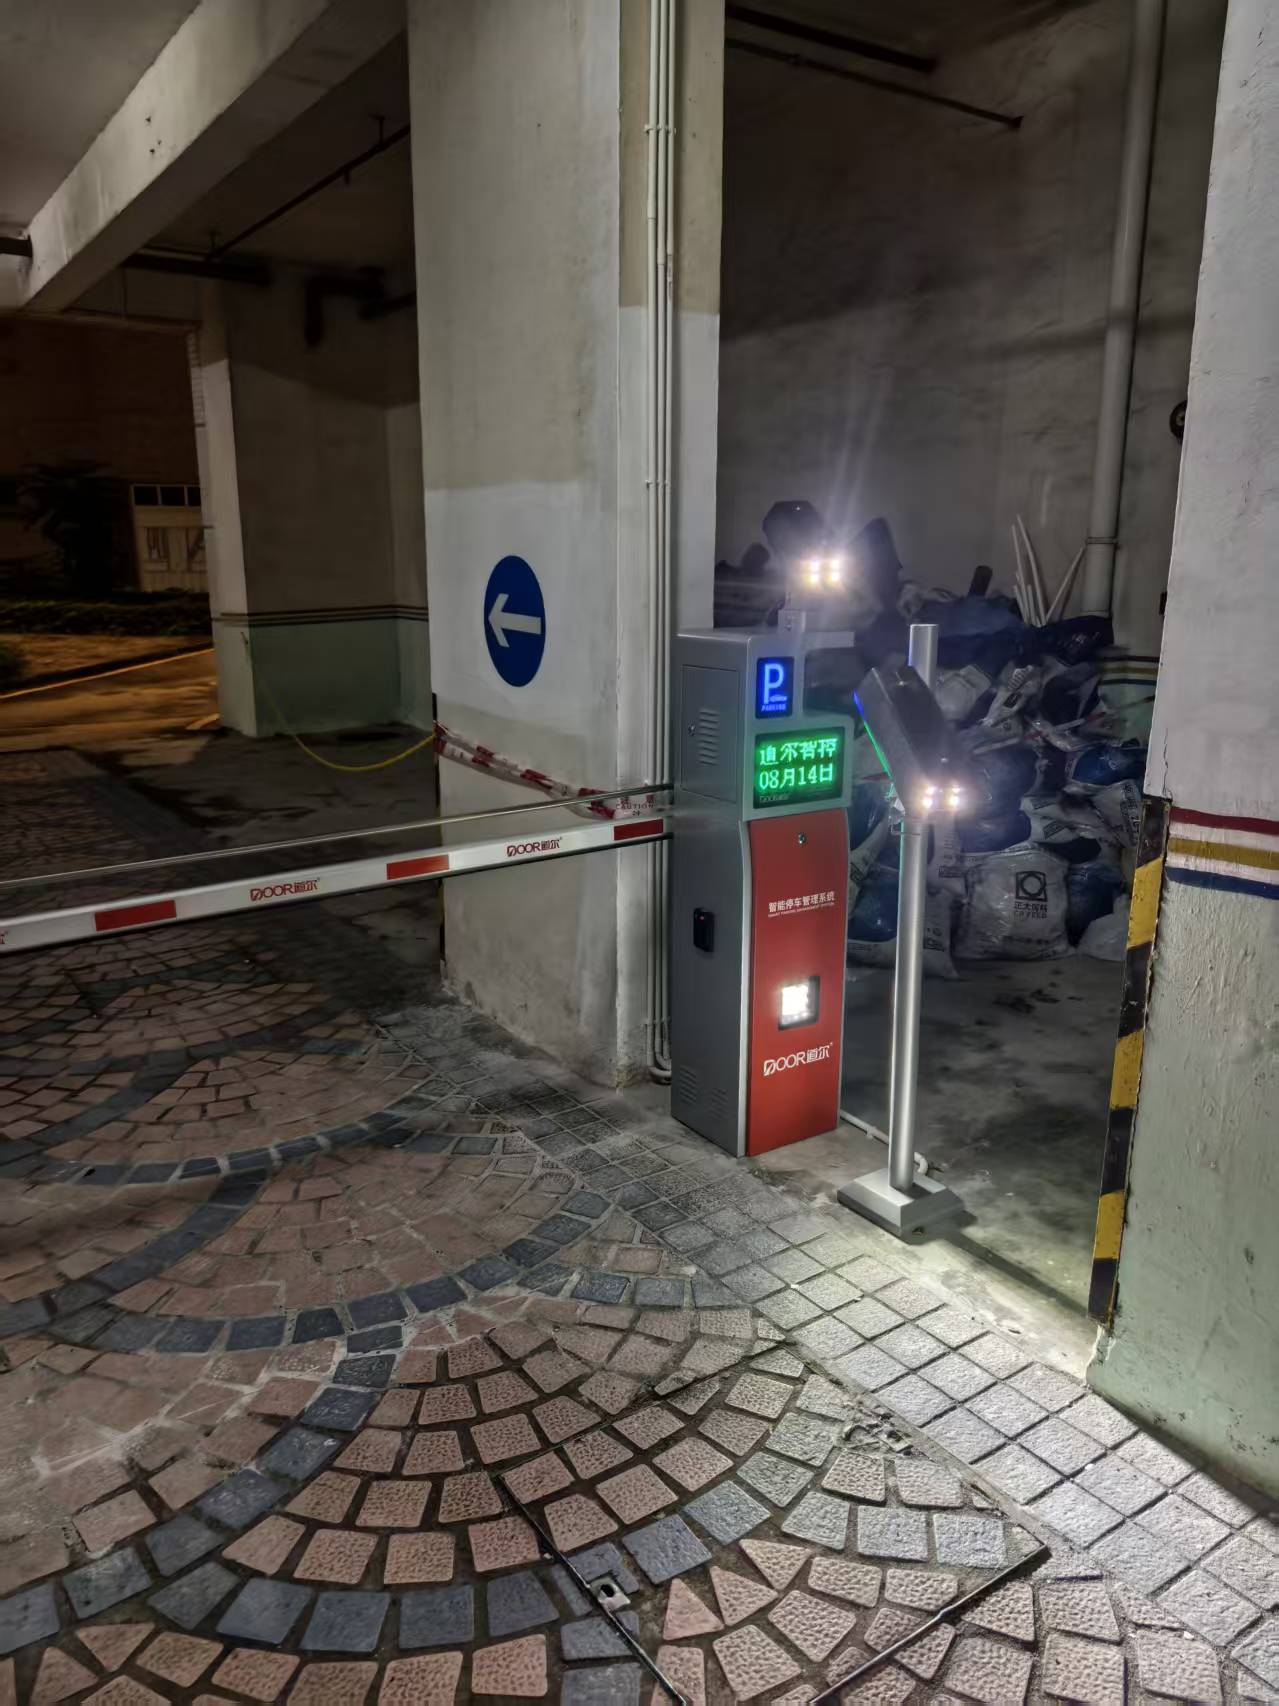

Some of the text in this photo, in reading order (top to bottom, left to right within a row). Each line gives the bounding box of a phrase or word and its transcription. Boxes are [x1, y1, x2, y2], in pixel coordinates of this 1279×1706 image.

[763, 663, 785, 704] P
[759, 763, 834, 790] 08月14日
[768, 891, 834, 913] 智能停车管理系统
